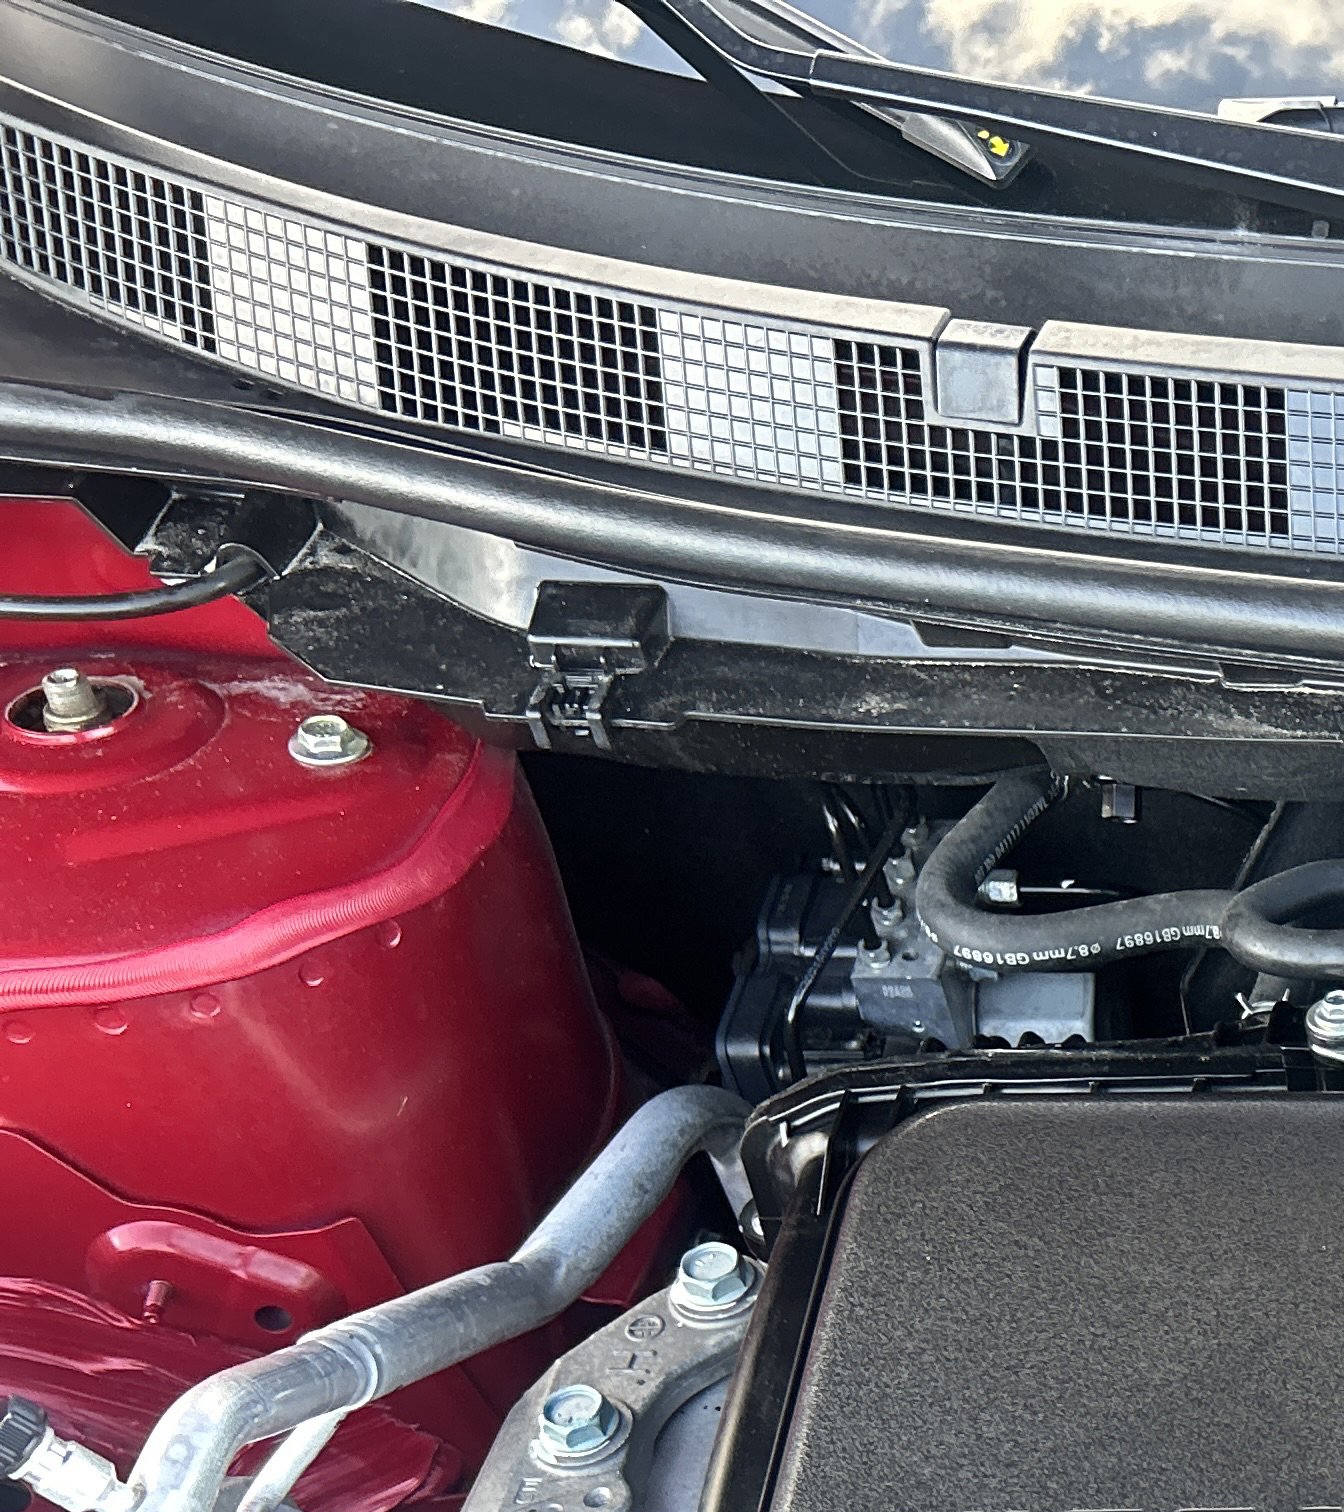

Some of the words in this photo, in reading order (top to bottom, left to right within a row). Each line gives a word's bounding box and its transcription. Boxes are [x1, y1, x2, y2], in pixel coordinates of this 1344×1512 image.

[1115, 926, 1181, 950] GB16897
[1181, 924, 1223, 940] 8.7mm
[953, 944, 1030, 966] GB16897
